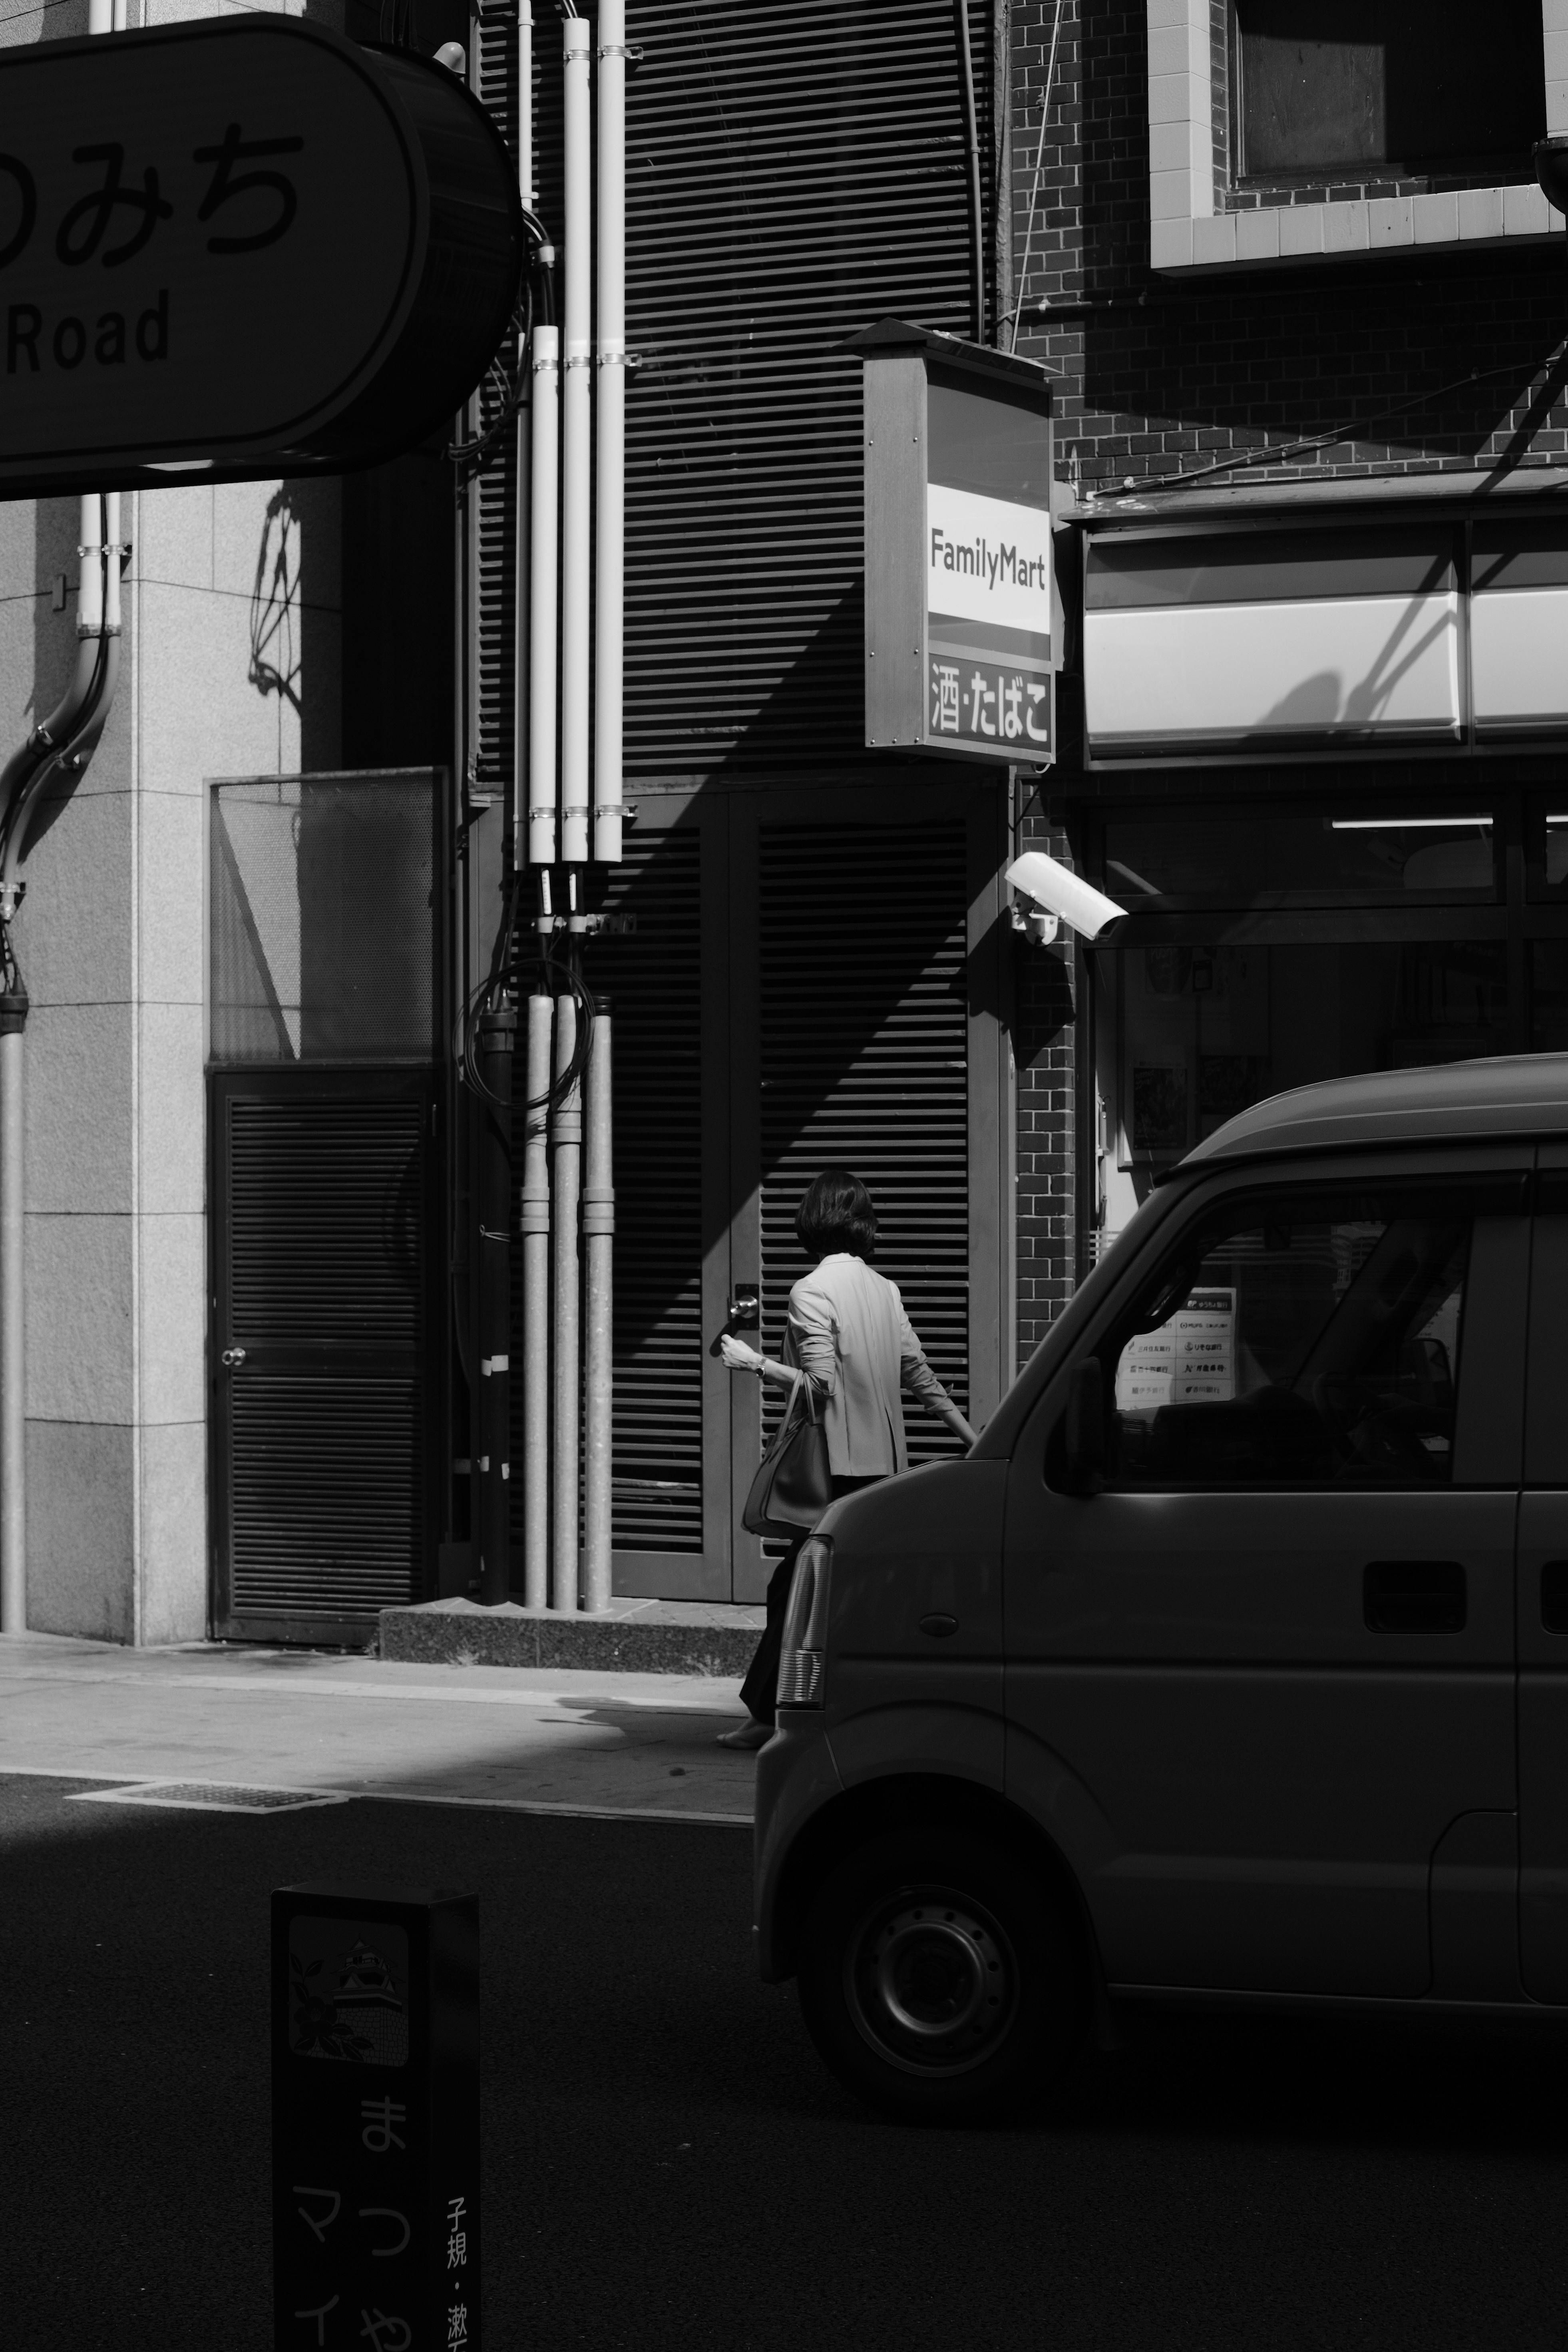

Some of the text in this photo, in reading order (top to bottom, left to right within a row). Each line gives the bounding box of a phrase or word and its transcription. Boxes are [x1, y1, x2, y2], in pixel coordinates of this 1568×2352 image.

[7, 289, 169, 374] Road
[931, 528, 1045, 590] FamilyMart
[931, 663, 1047, 742] 酒・たばこ
[292, 2185, 341, 2347] マイ
